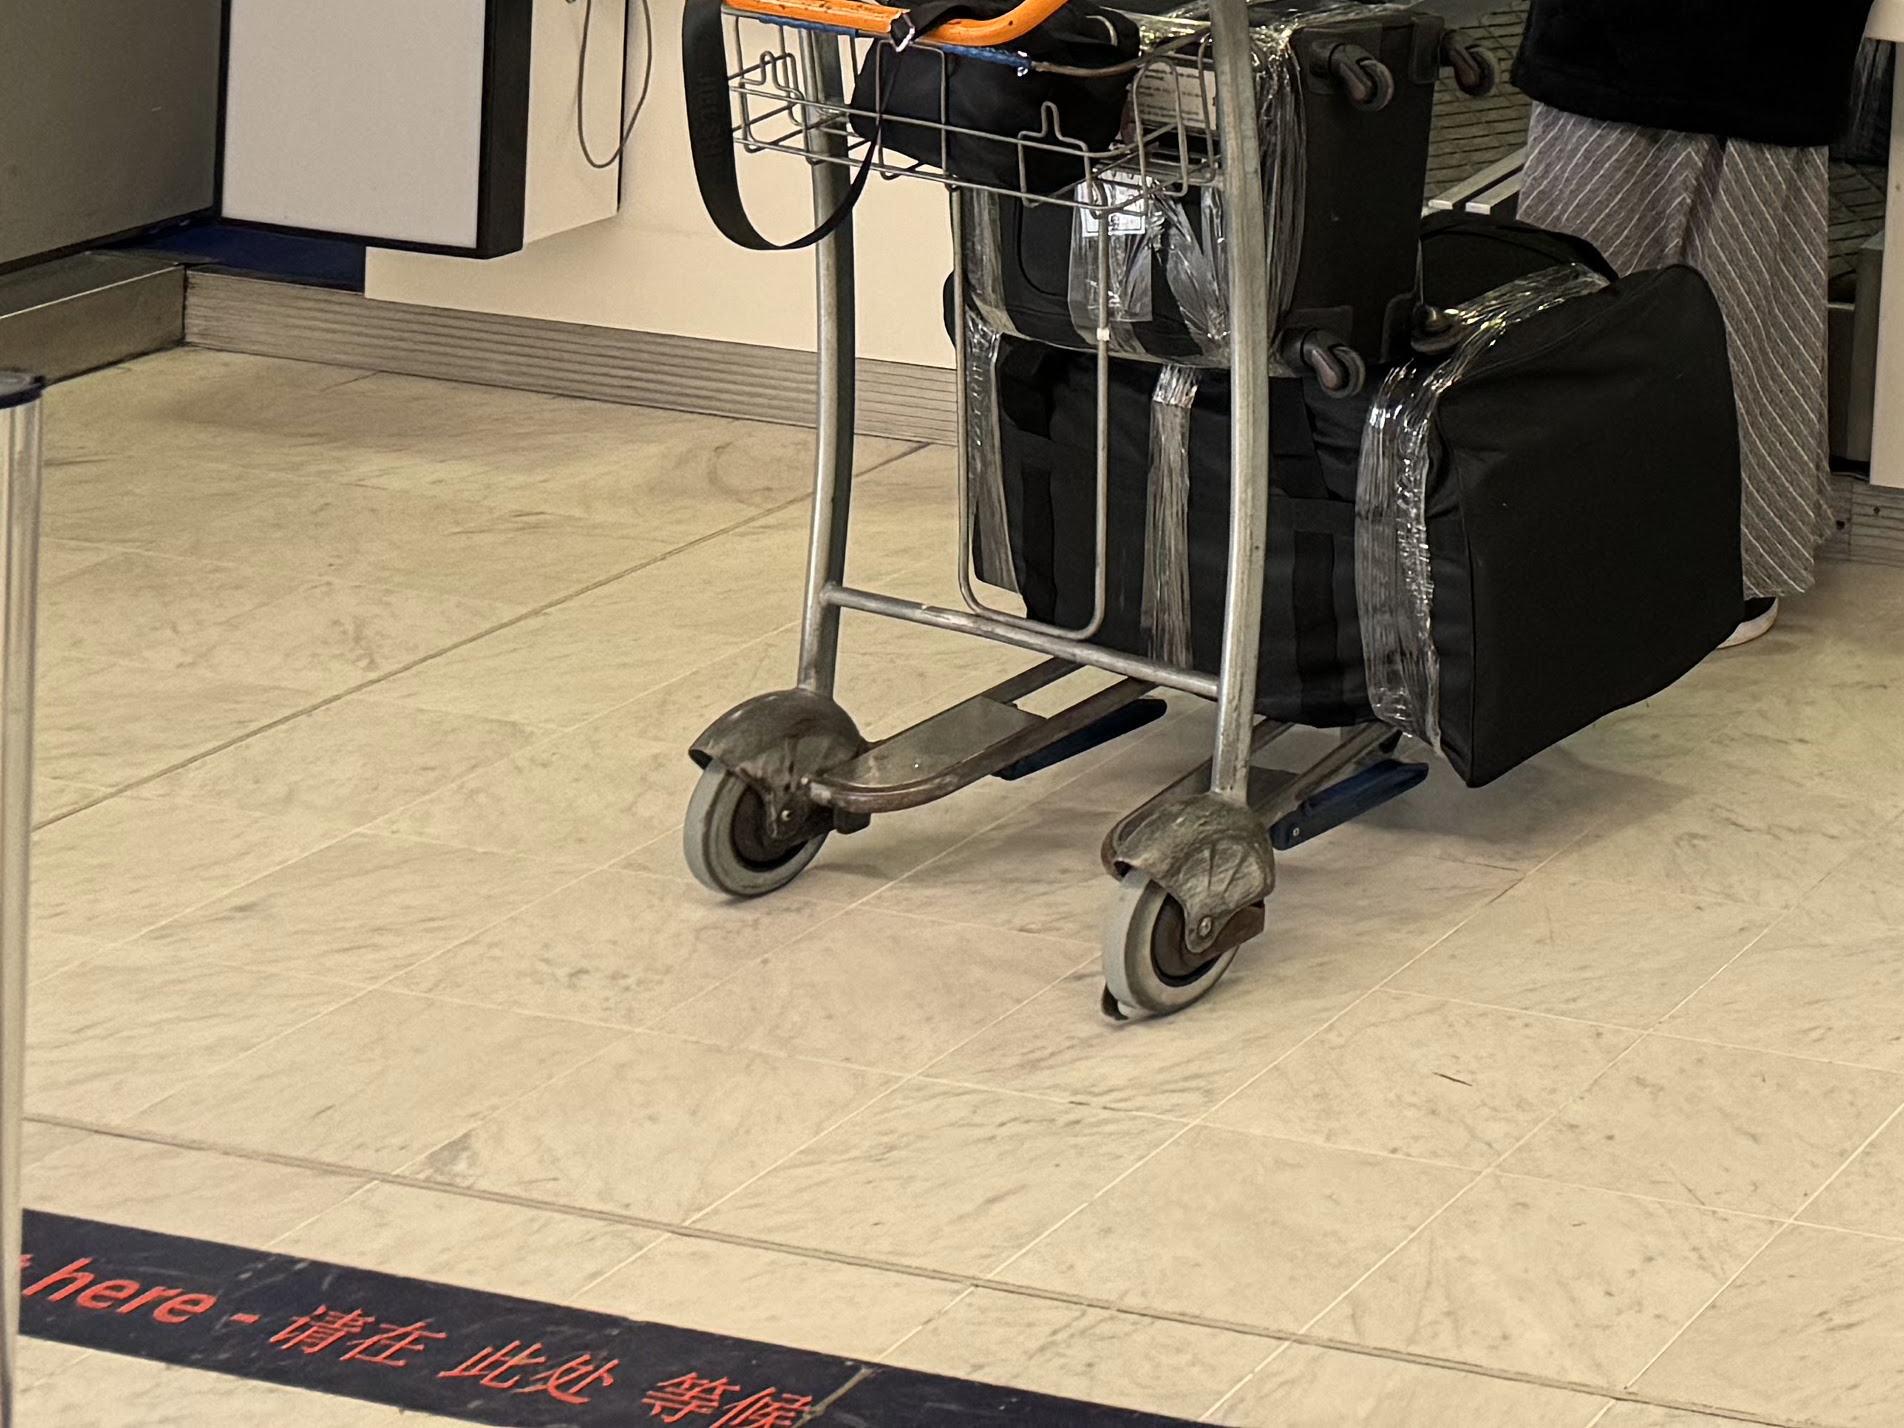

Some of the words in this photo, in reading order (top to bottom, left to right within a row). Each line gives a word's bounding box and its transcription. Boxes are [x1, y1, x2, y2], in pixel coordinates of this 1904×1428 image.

[22, 1256, 218, 1324] here
[268, 1303, 448, 1368] 请在
[435, 1340, 622, 1405] 此处
